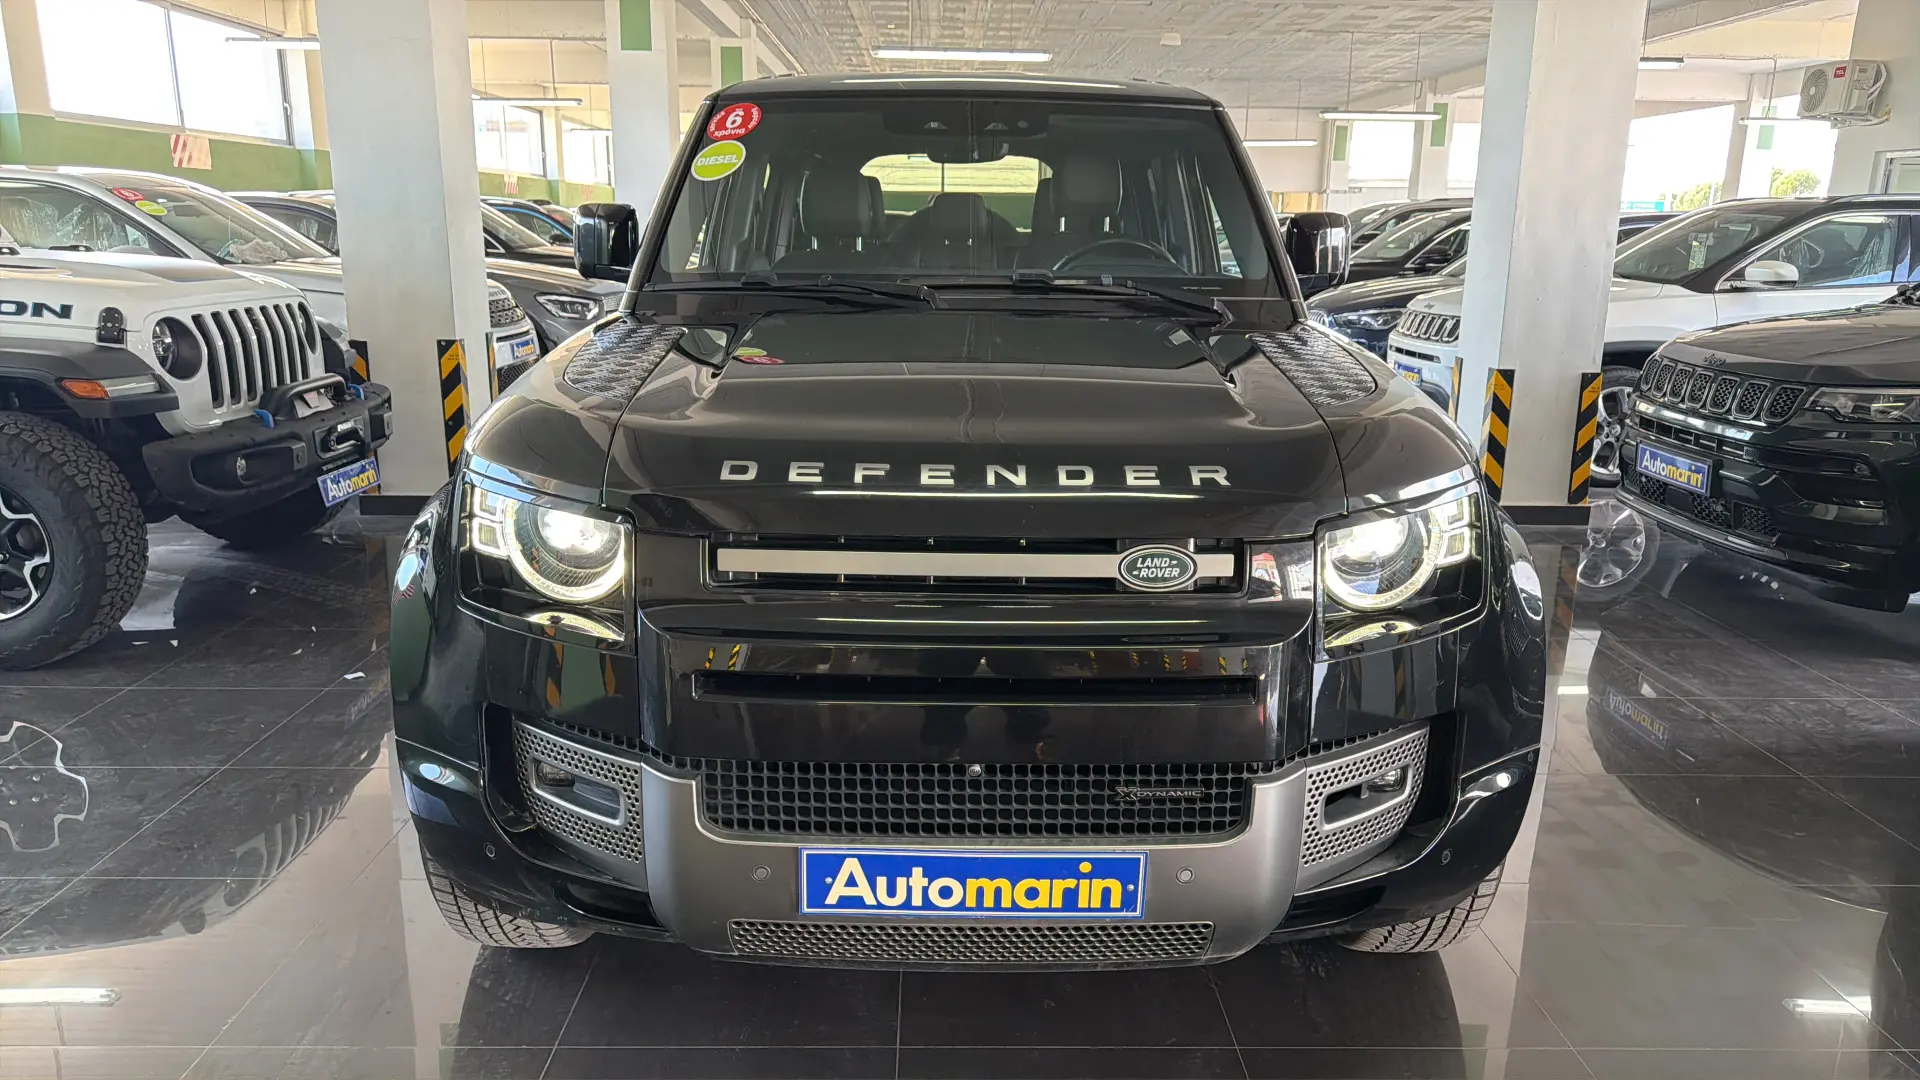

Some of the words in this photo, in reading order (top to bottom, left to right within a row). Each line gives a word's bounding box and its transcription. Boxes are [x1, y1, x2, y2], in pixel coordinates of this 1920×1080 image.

[725, 110, 745, 129] 6
[713, 128, 745, 137] χρόνια
[696, 155, 738, 166] DIESEL
[719, 460, 1231, 486] DEFENDER
[1641, 449, 1703, 488] Automarin
[326, 464, 377, 501] Automarin
[1136, 557, 1170, 568] LAND
[1139, 567, 1180, 578] ROVER
[824, 857, 1122, 909] Automarin
